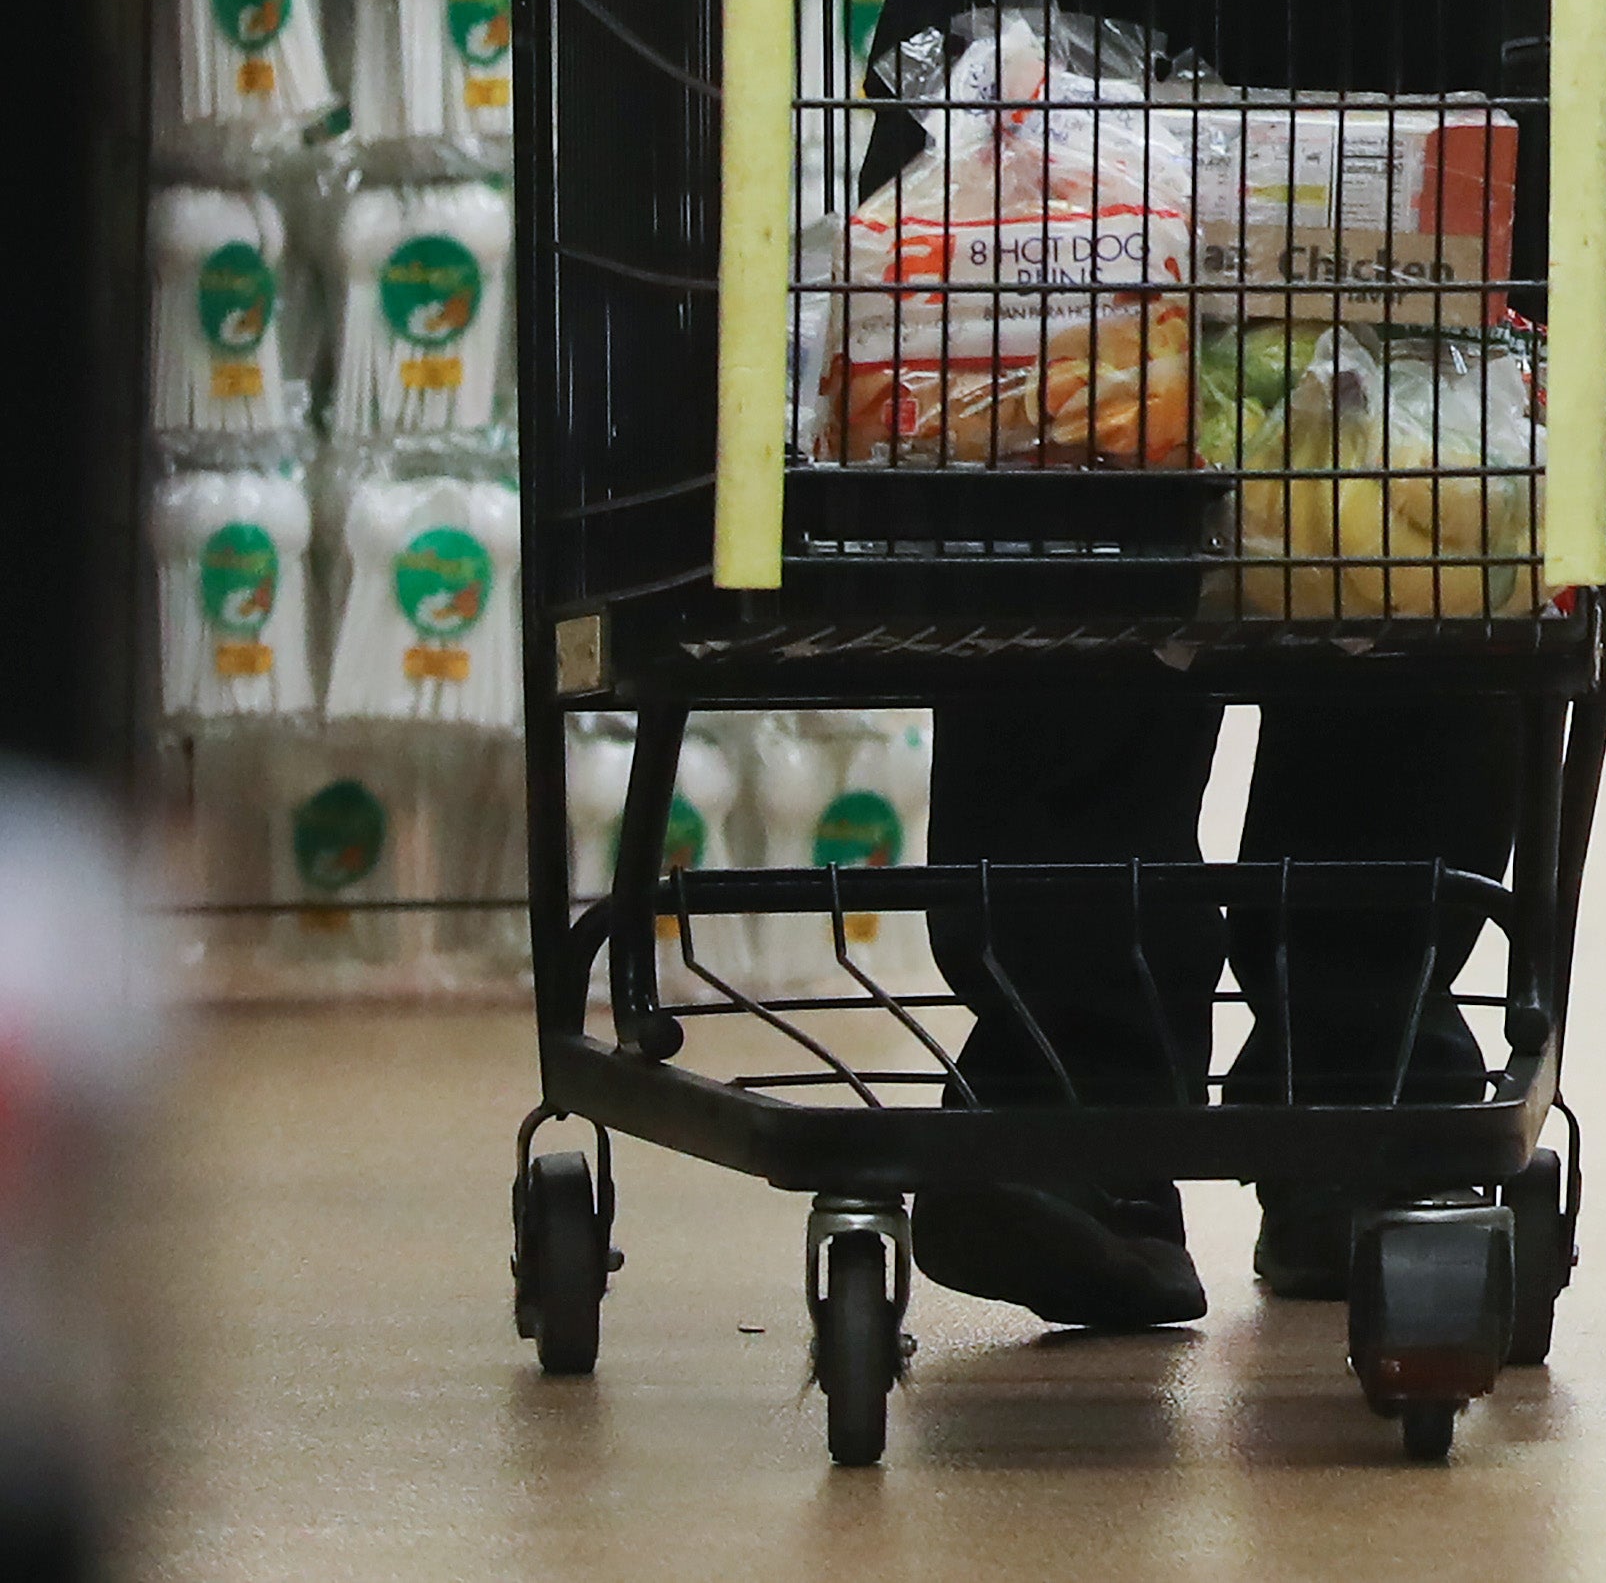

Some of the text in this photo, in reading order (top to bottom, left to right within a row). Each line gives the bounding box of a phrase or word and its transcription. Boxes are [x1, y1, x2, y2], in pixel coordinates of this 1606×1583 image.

[970, 232, 1149, 266] 8 HOT DOG
